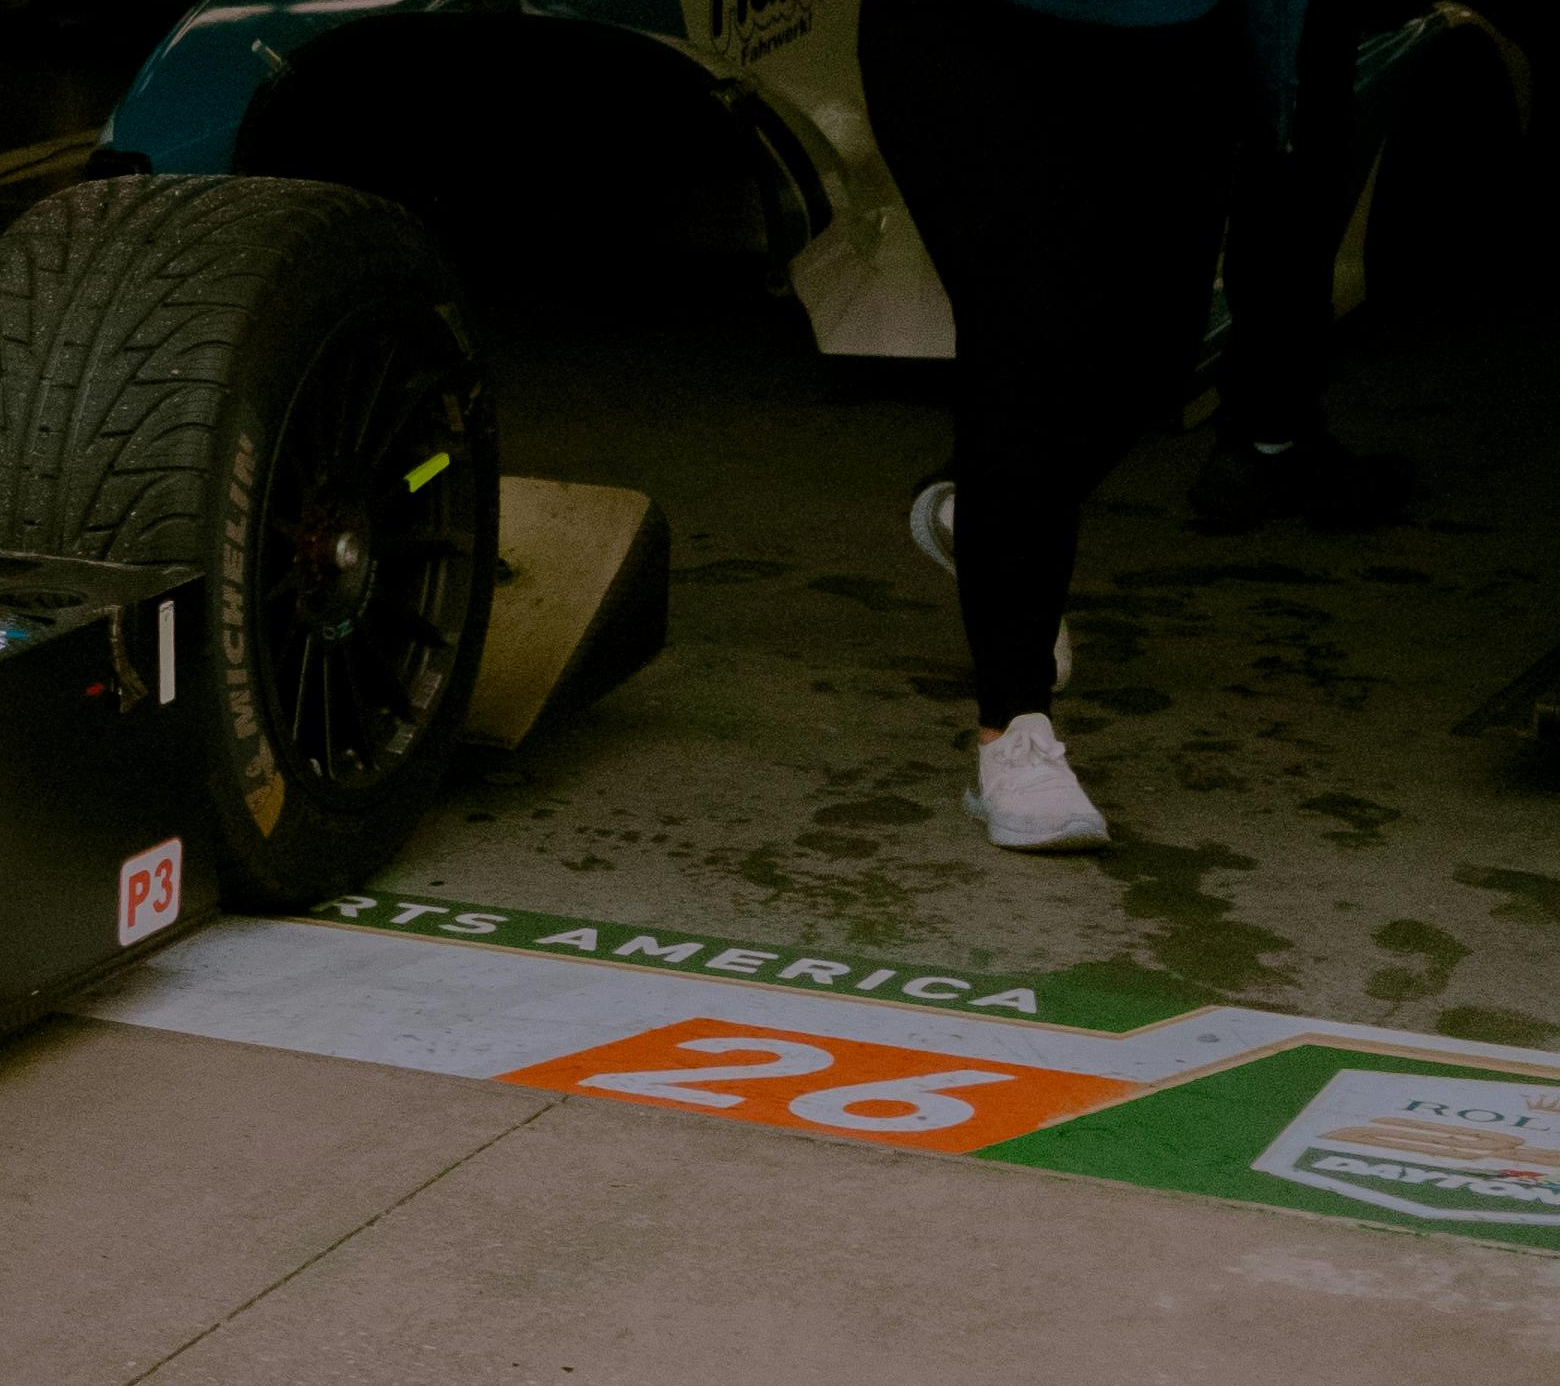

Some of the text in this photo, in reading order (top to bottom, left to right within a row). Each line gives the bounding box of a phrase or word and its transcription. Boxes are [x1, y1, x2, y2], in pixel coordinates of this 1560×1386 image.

[219, 432, 261, 746] MICHELIN
[127, 858, 176, 927] P3
[323, 895, 1039, 1014] RTS AMERICA
[576, 1035, 1016, 1133] 26
[1399, 1098, 1551, 1131] ROL
